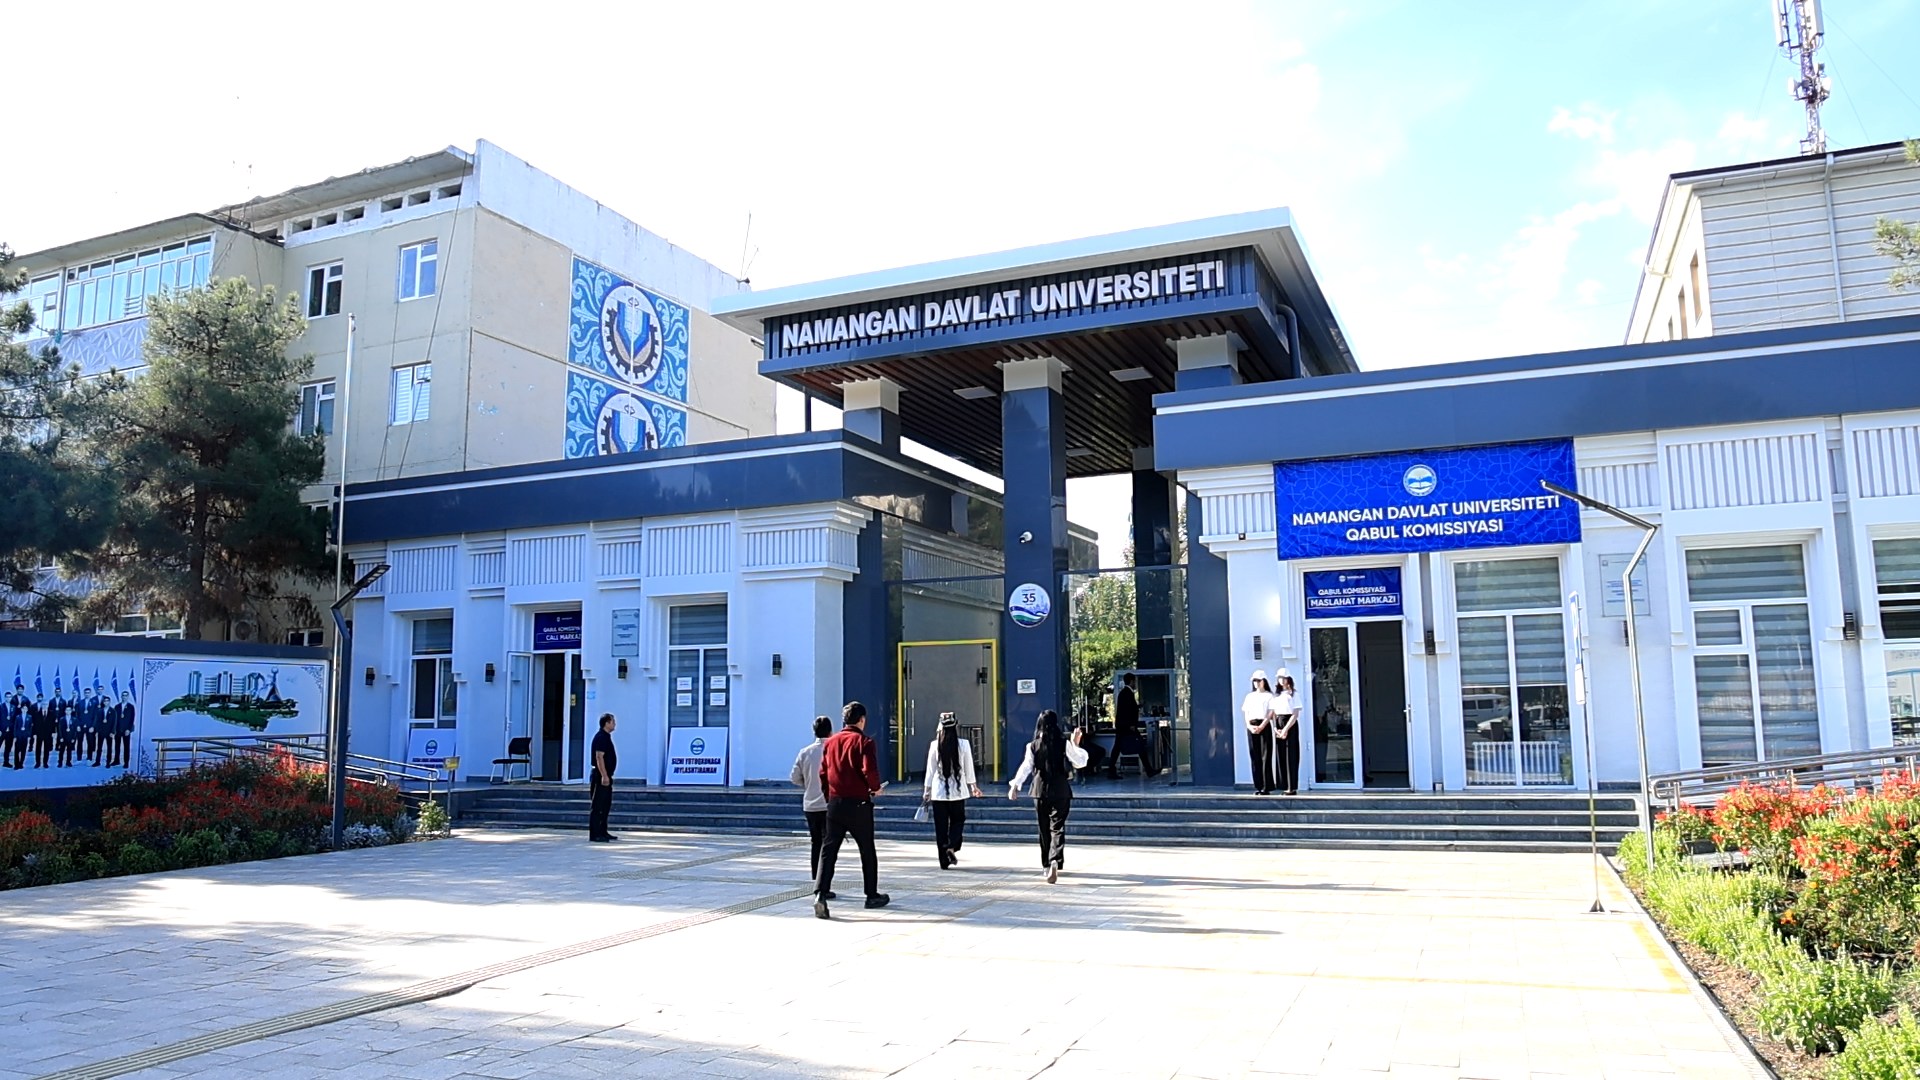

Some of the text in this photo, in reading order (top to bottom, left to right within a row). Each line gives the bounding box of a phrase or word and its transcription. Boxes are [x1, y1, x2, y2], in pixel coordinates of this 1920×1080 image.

[783, 260, 1225, 349] NAMANGAN DAVLAT UNIVERSITETI
[1292, 495, 1560, 526] NAMANGAN DAVLAT UNIVERSITETI
[1346, 519, 1504, 542] QABUL KOMISSIYASI
[1022, 593, 1036, 603] 35
[1343, 586, 1386, 594] KOMISSIYASI
[1311, 596, 1396, 606] MASLAHAT MARKAZI
